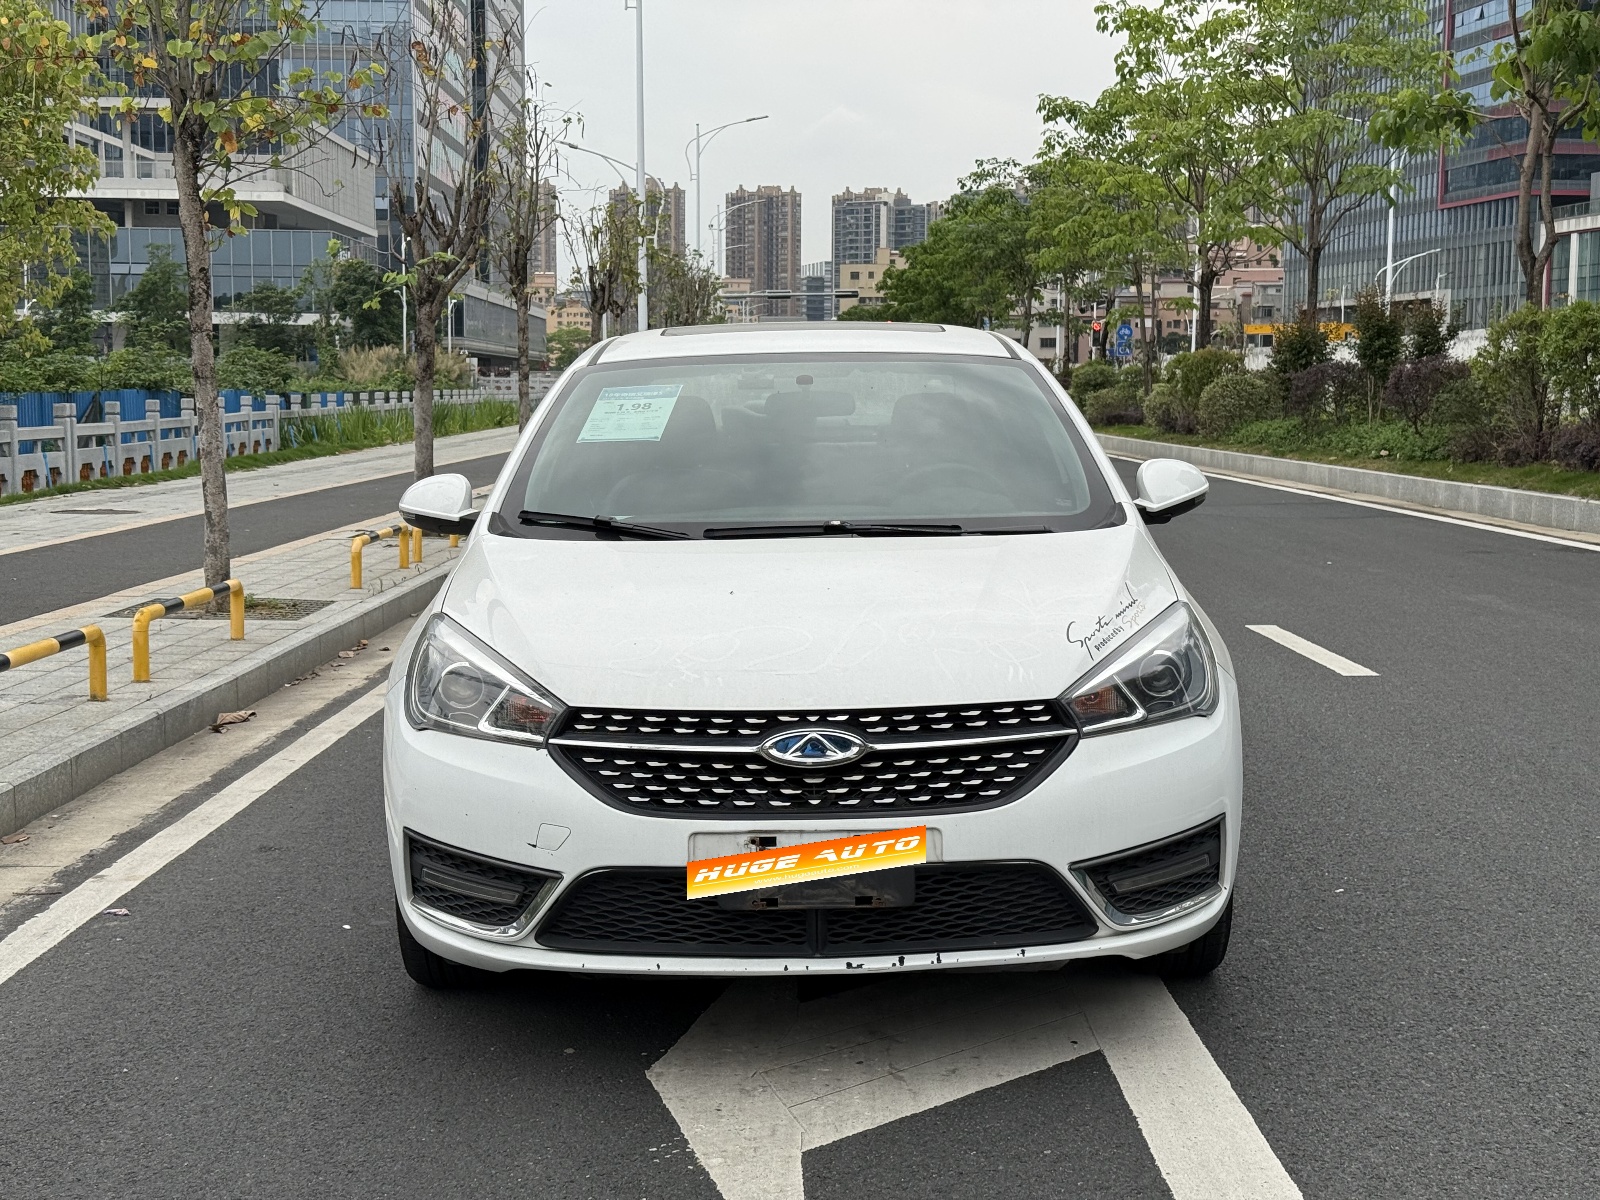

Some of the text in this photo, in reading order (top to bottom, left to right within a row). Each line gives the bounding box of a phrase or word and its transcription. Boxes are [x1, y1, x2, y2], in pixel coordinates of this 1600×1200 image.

[617, 402, 652, 411] 1.98
[1066, 581, 1138, 661] Sports mind
[1121, 601, 1146, 628] Sports
